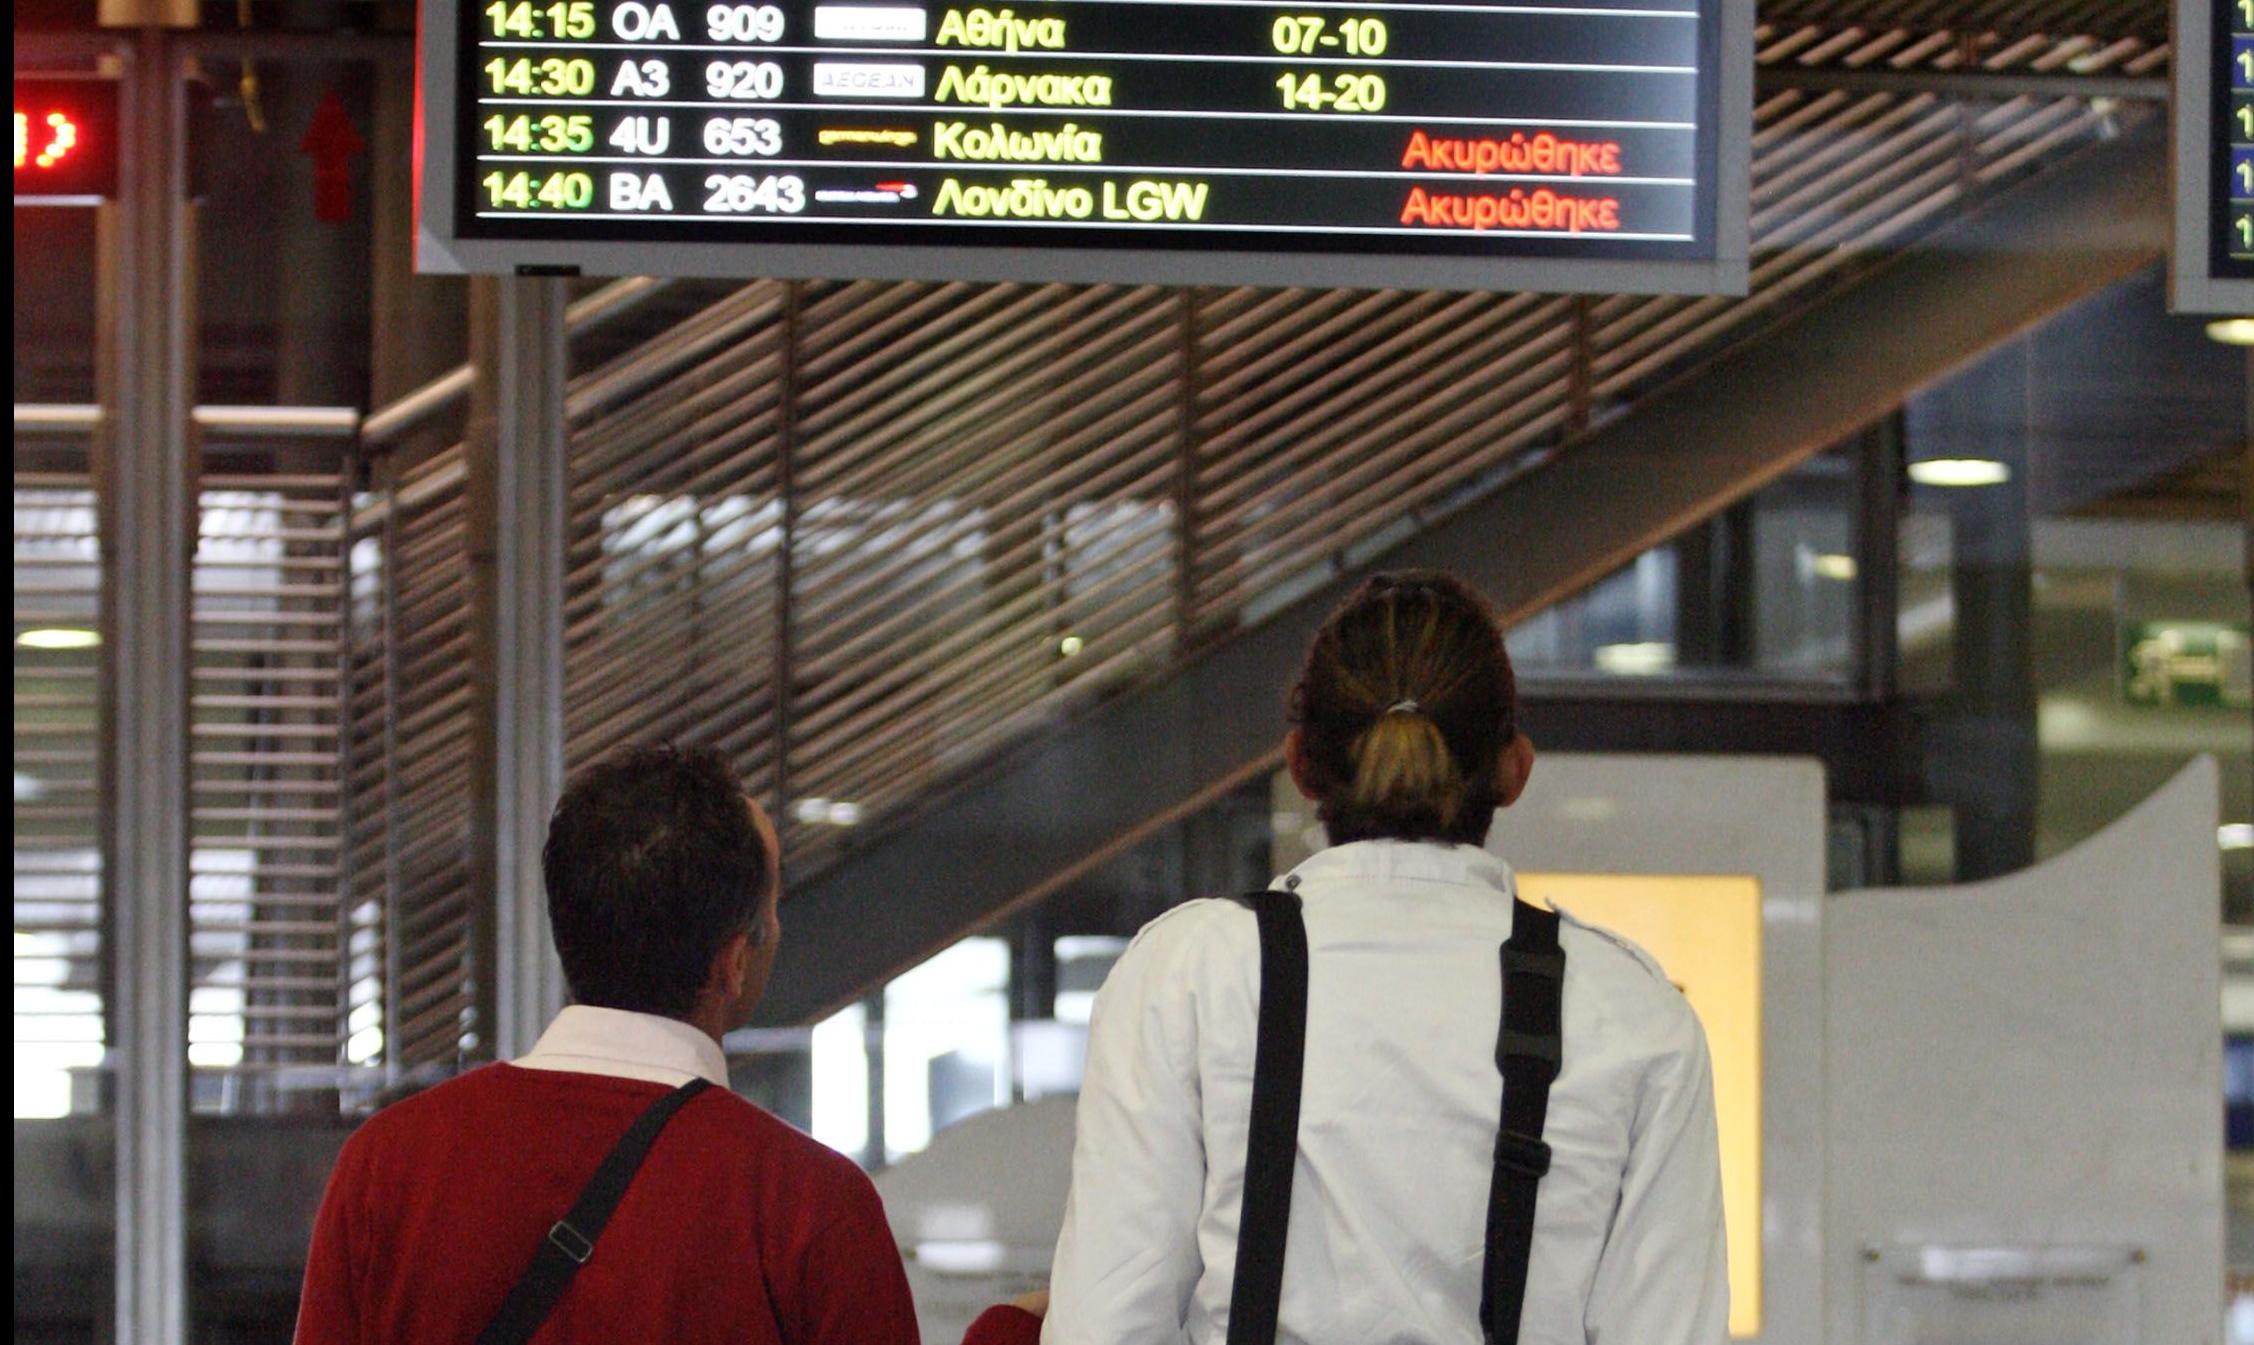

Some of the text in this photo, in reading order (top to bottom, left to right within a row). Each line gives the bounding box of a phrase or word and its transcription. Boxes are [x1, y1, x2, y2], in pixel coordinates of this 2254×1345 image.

[486, 1, 1387, 56] 14:15 OA 909 Αθήνα 07-10
[485, 57, 595, 96] 14:30
[610, 59, 671, 97] A3
[705, 61, 784, 99] 920
[934, 65, 1112, 111] Λάρνακα
[1276, 72, 1386, 112] 14-20
[484, 114, 594, 153] 14:35
[609, 116, 670, 155] 4U
[703, 117, 783, 156] 653
[934, 121, 1102, 162] Κολωνία
[1402, 129, 1621, 176] Ακυρώθηκε
[483, 171, 1620, 233] 14:40 BA 2643 Λονδίνο LGW Ακυρώθηκε
